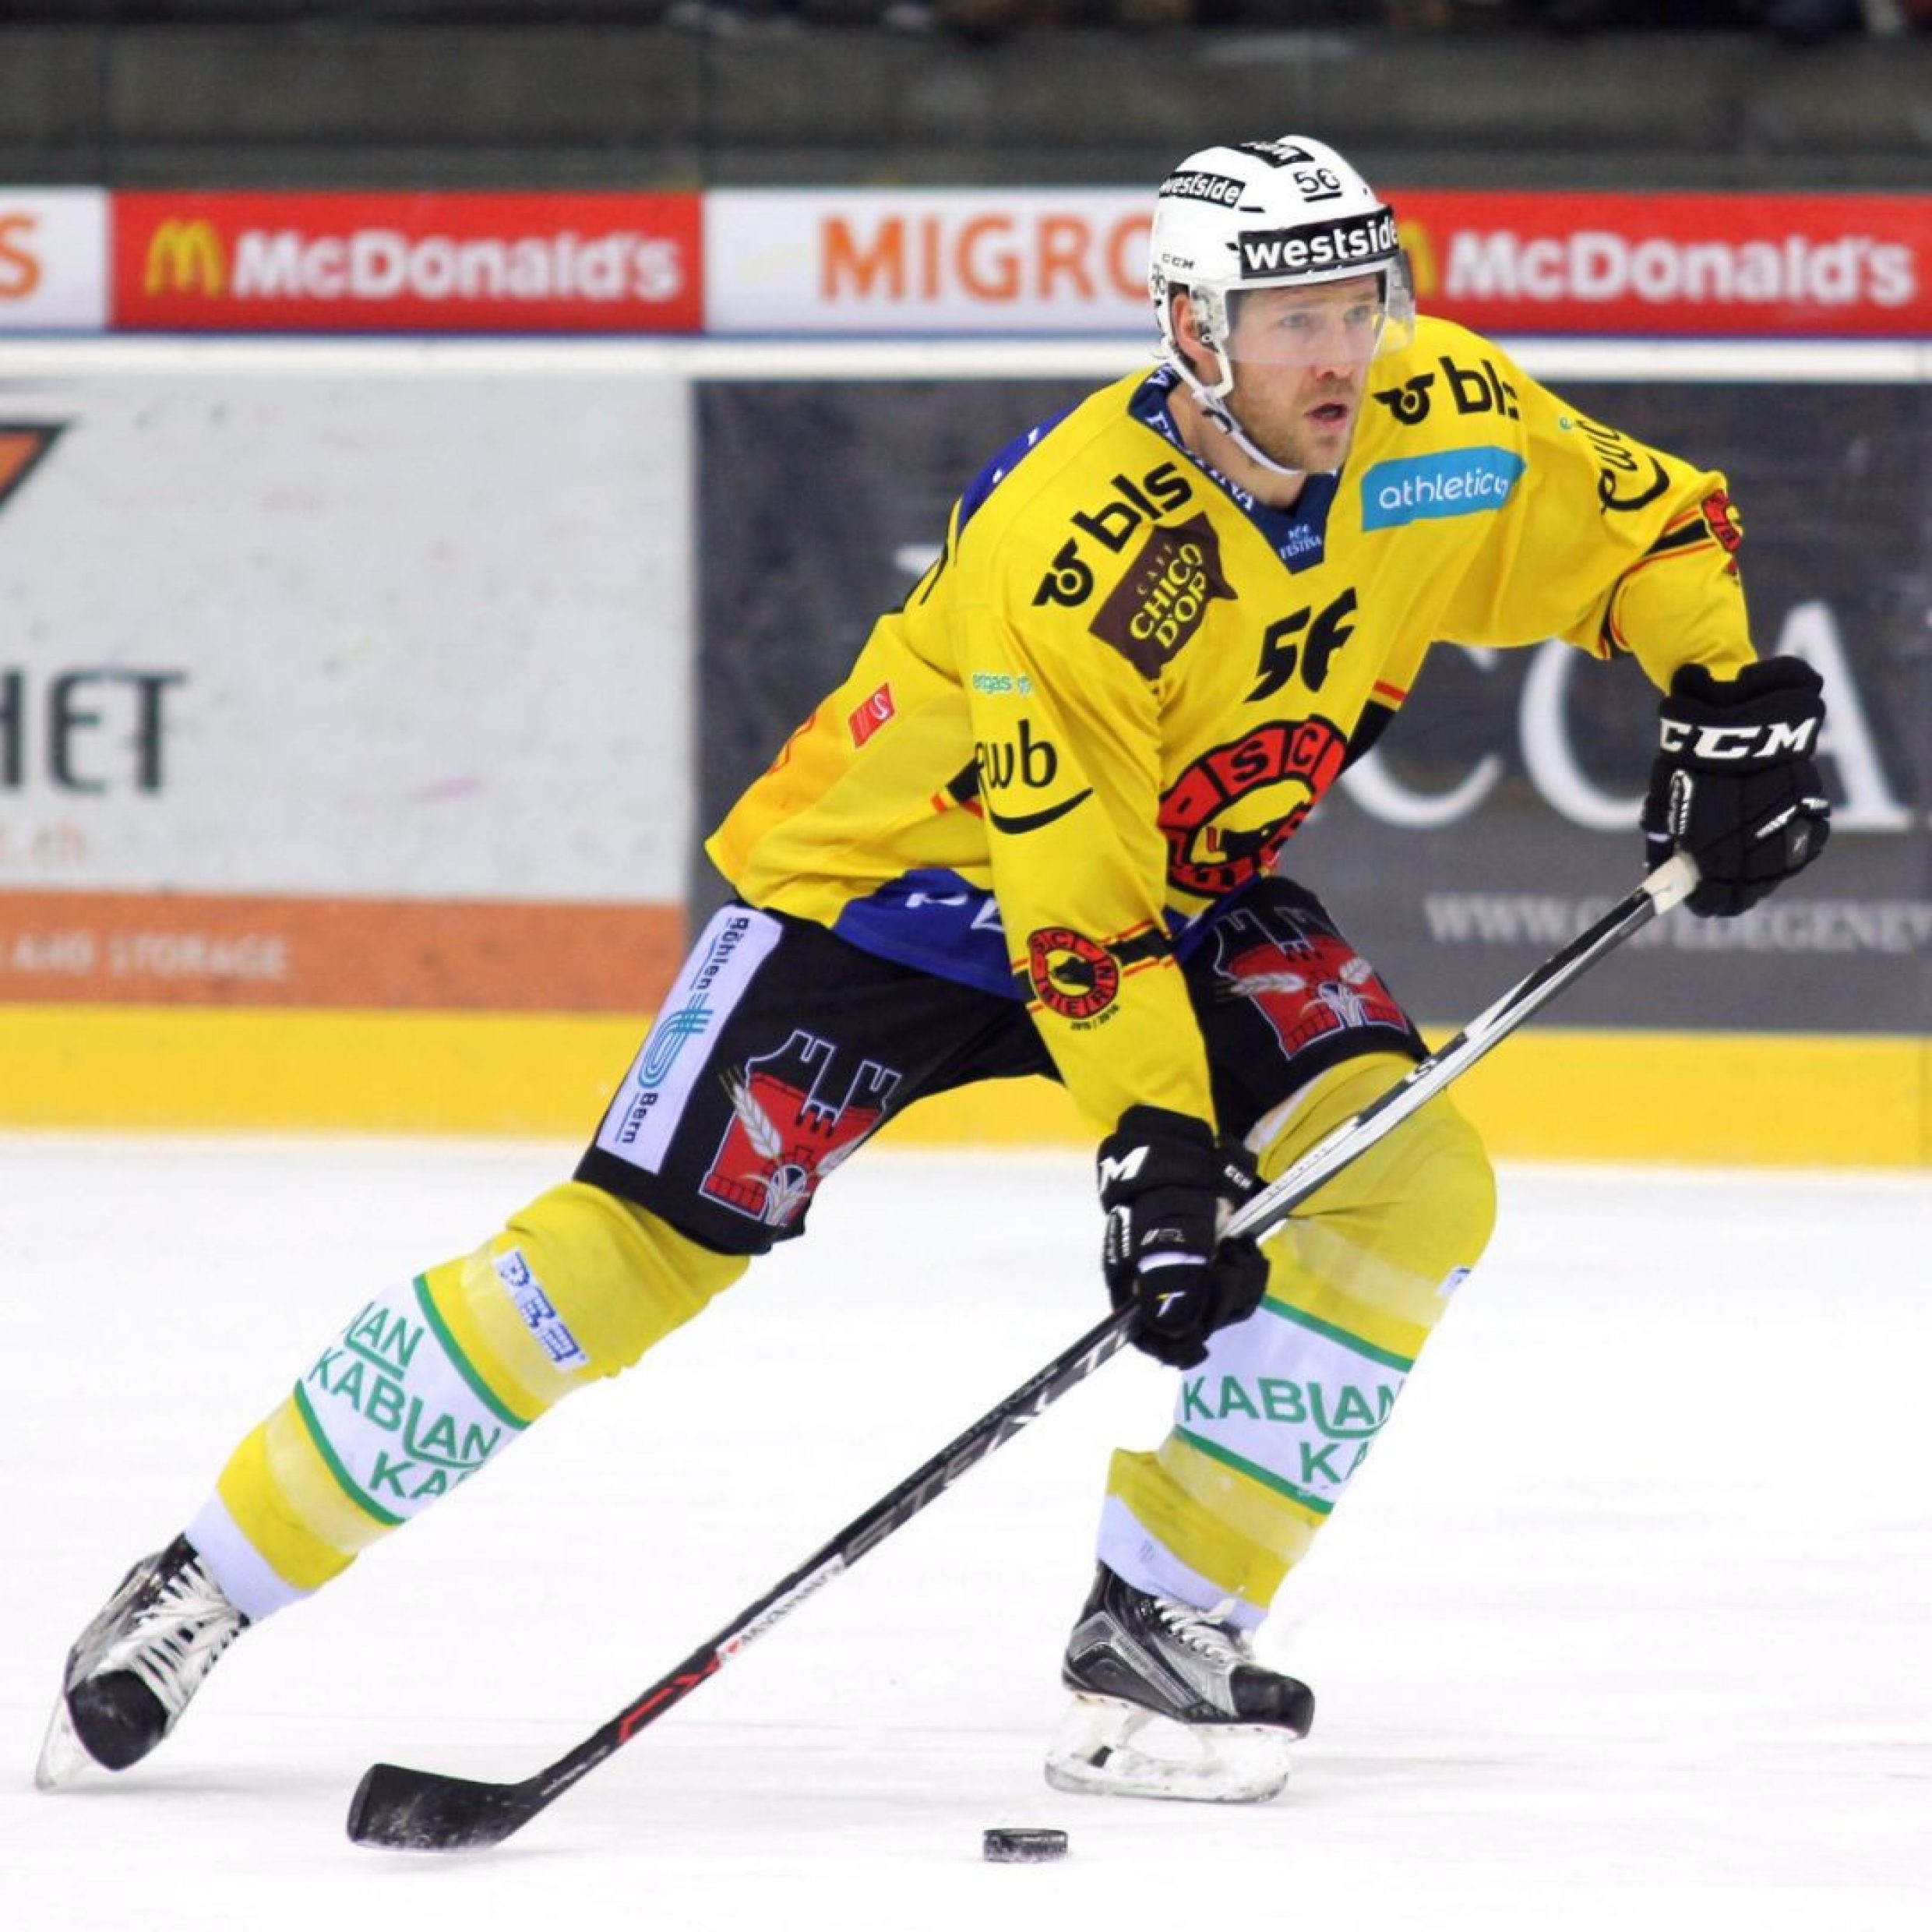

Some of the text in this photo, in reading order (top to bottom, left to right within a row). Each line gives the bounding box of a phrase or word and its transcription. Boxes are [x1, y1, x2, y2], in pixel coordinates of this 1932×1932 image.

[1292, 167, 1341, 194] 56
[233, 228, 680, 300] McDonald's
[1445, 231, 1915, 306] McDonald's
[1069, 461, 1193, 554] bls
[1659, 717, 1817, 760] CCM
[622, 1092, 659, 1144] Bern
[307, 1346, 502, 1469] KABLAN
[368, 1450, 481, 1500] KA
